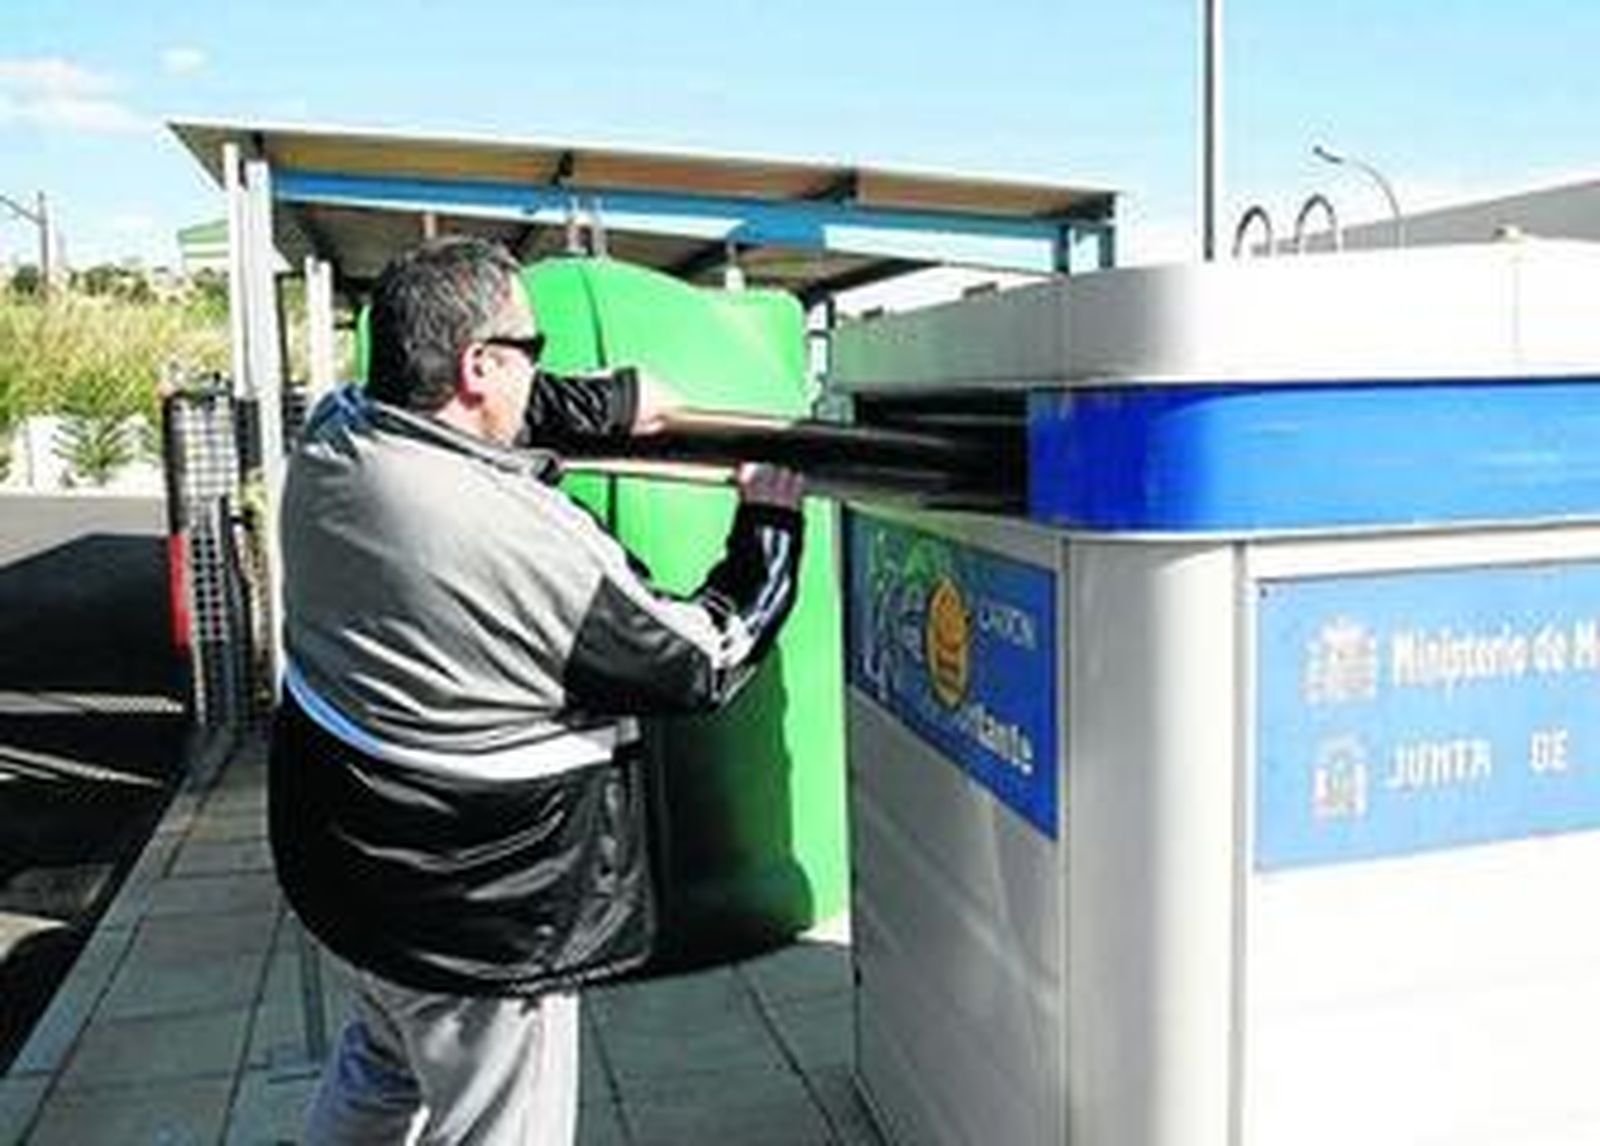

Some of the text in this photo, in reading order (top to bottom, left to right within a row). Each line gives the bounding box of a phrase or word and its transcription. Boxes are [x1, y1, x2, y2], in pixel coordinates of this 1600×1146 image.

[1534, 622, 1567, 671] de
[1386, 728, 1569, 790] JUNTA DE
